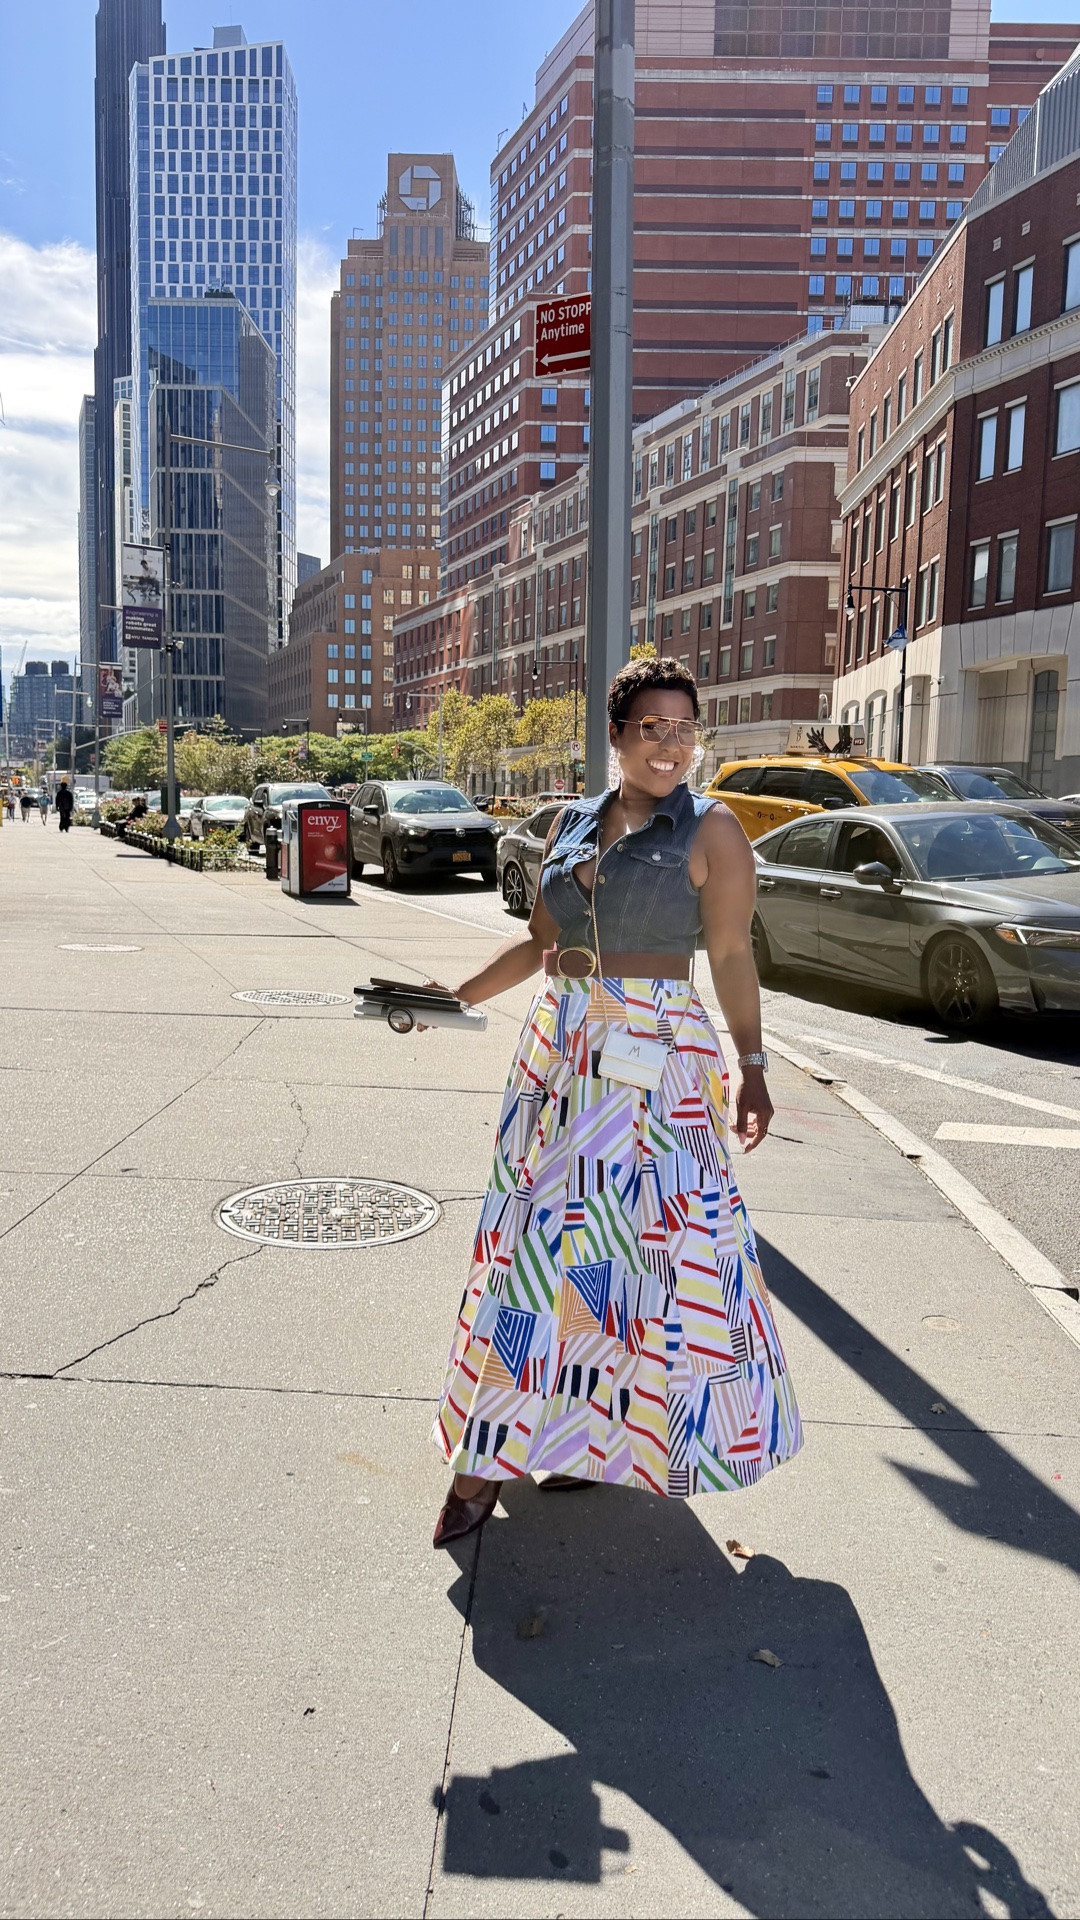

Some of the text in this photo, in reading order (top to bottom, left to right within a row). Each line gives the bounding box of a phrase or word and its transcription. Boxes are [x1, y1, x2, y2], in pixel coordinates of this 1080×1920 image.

[540, 309, 555, 324] NO
[540, 323, 585, 341] Anytime
[307, 815, 342, 832] envy
[628, 1045, 640, 1058] M
